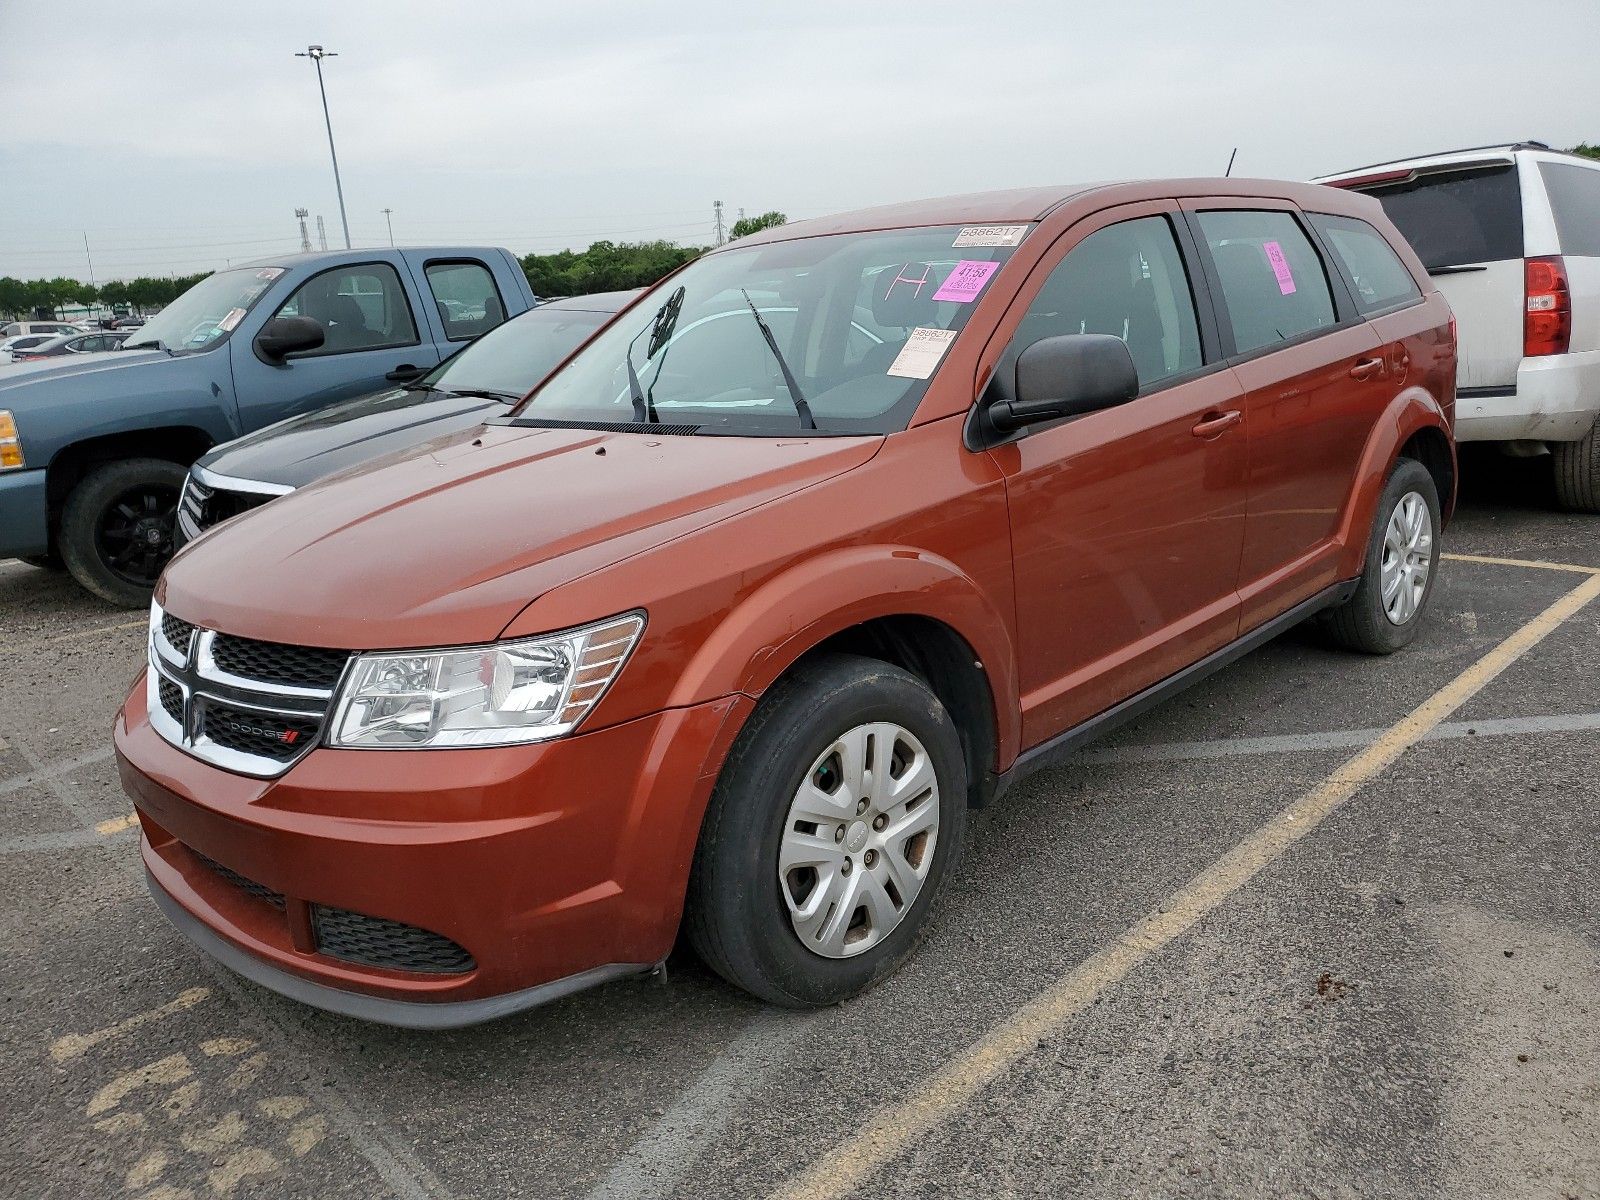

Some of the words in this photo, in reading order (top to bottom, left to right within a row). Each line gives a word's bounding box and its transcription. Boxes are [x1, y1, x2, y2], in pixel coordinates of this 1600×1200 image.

[961, 227, 1021, 237] 5886217
[958, 267, 988, 278] 41:58
[884, 262, 932, 302] H
[230, 722, 288, 741] DODGE
